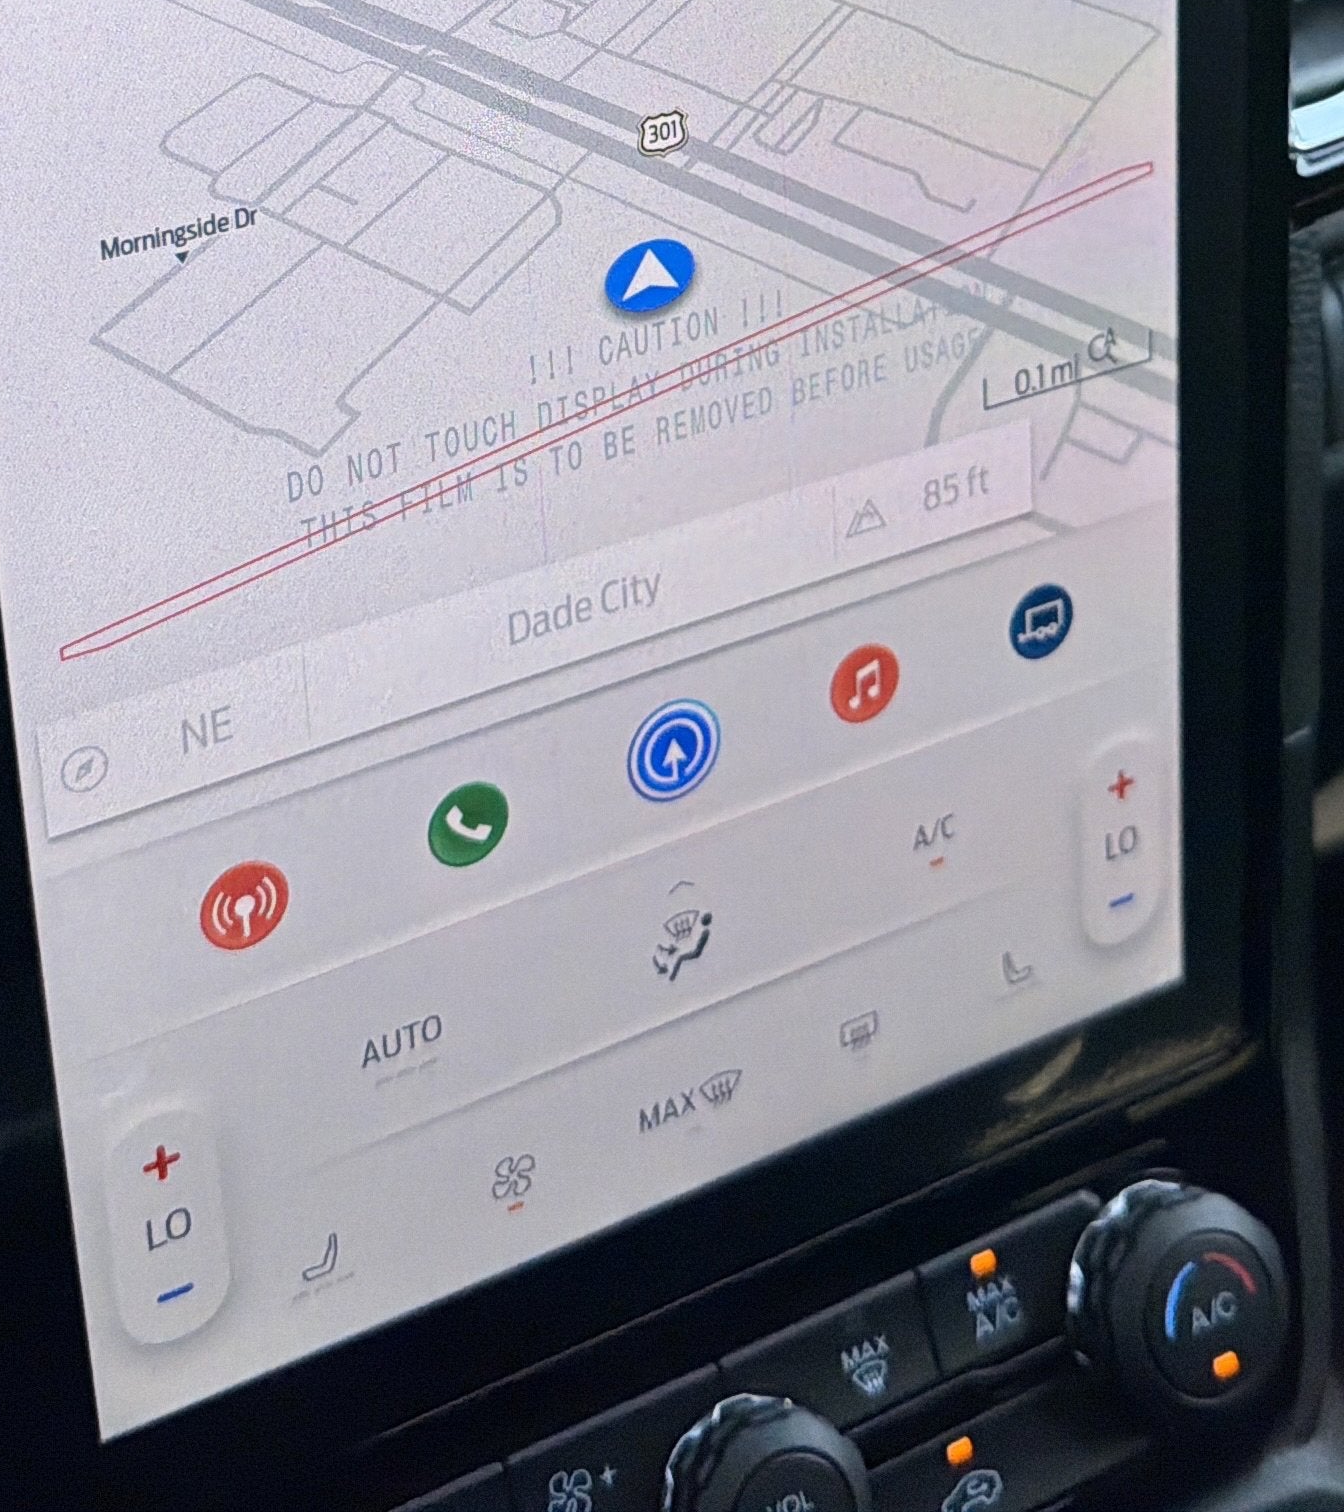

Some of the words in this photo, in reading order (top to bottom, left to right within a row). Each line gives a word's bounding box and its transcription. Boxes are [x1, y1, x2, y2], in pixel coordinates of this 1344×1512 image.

[648, 119, 677, 144] 301
[100, 212, 231, 261] Morningside
[234, 206, 258, 230] Dr
[599, 306, 718, 366] CAUTION
[1014, 363, 1044, 396] 0.1
[287, 465, 324, 503] DO
[347, 442, 402, 488] NOT
[424, 411, 516, 463] TOUCH
[537, 371, 659, 431] DISPLAY
[679, 338, 780, 393] DURING
[300, 500, 377, 548] THIS
[399, 471, 474, 522] FILM
[496, 458, 529, 494] IS
[549, 440, 583, 476] TO
[604, 424, 636, 461] BE
[655, 386, 773, 445] REMOVED
[792, 352, 889, 408] BEFORE
[923, 473, 959, 512] 85
[968, 465, 990, 497] ft
[508, 593, 593, 646] Dade
[600, 572, 661, 614] City
[180, 707, 233, 754] NE
[912, 814, 956, 852] A/C
[1105, 825, 1139, 862] LO
[361, 1014, 443, 1068] AUTO
[639, 1088, 697, 1133] MAX
[144, 1207, 193, 1252] LO
[966, 1276, 1017, 1312] MAX
[1192, 1291, 1238, 1336] A/C
[841, 1334, 890, 1373] MAX
